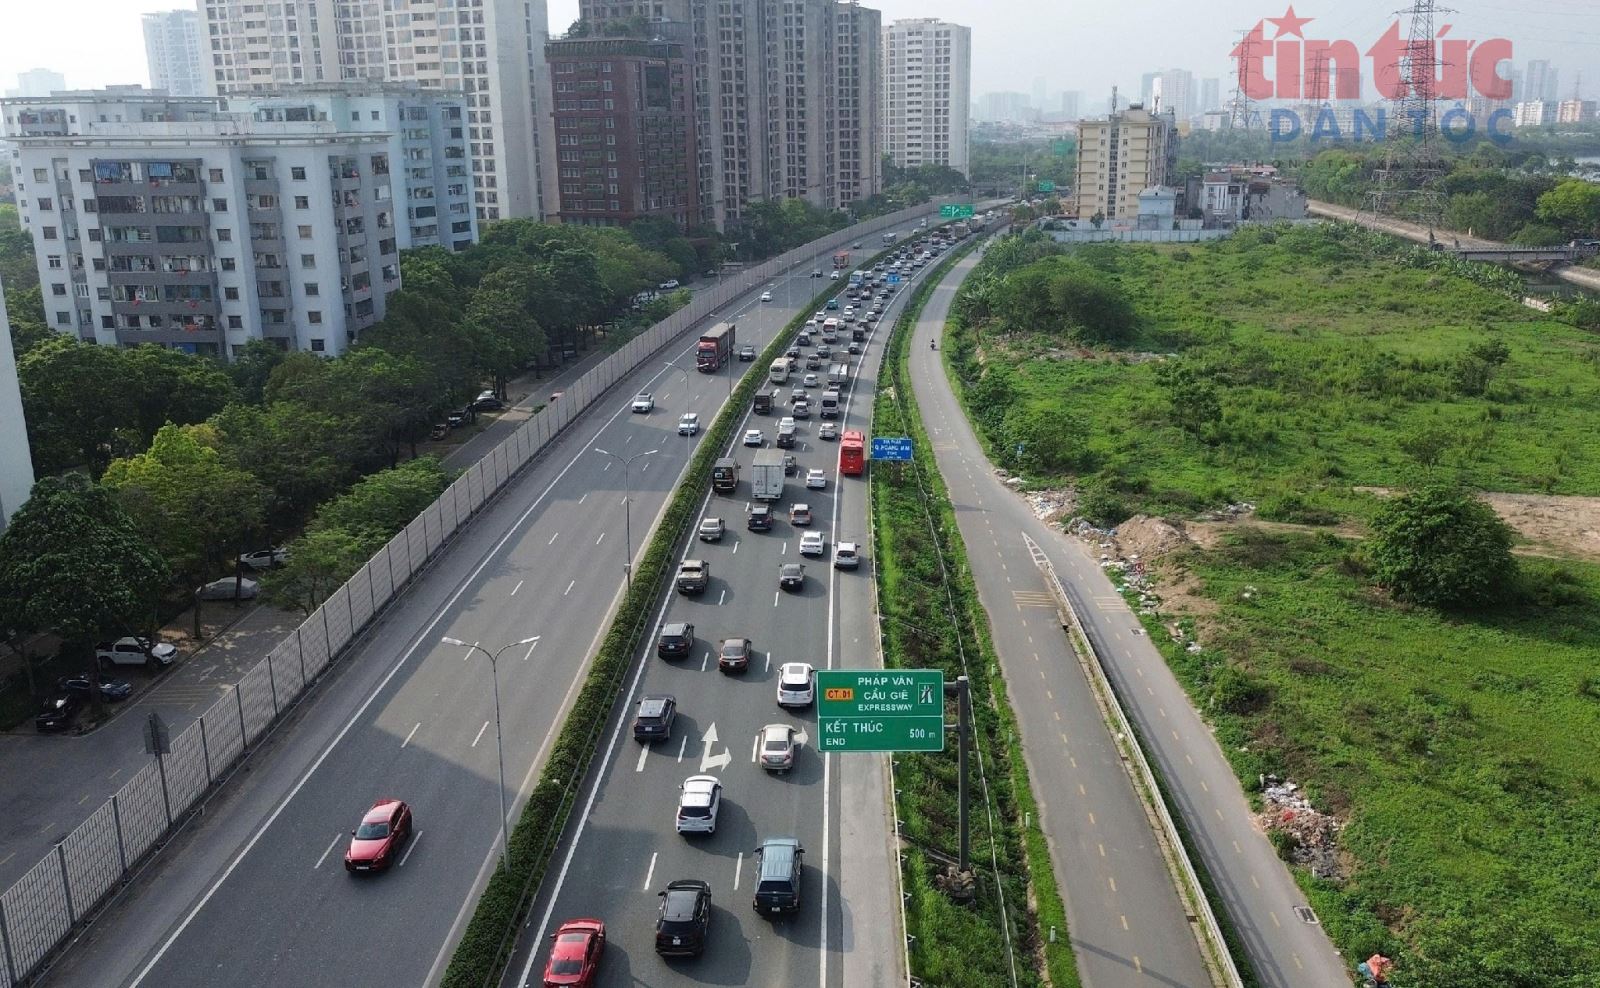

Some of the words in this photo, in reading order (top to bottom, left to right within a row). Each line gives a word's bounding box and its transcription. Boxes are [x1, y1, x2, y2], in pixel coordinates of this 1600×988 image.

[858, 674, 888, 686] PHÁP
[858, 703, 913, 711] EXPRESSWAY
[825, 719, 848, 733] KẾT
[853, 720, 883, 733] THÚC
[909, 728, 925, 738] 500
[826, 738, 846, 746] END
